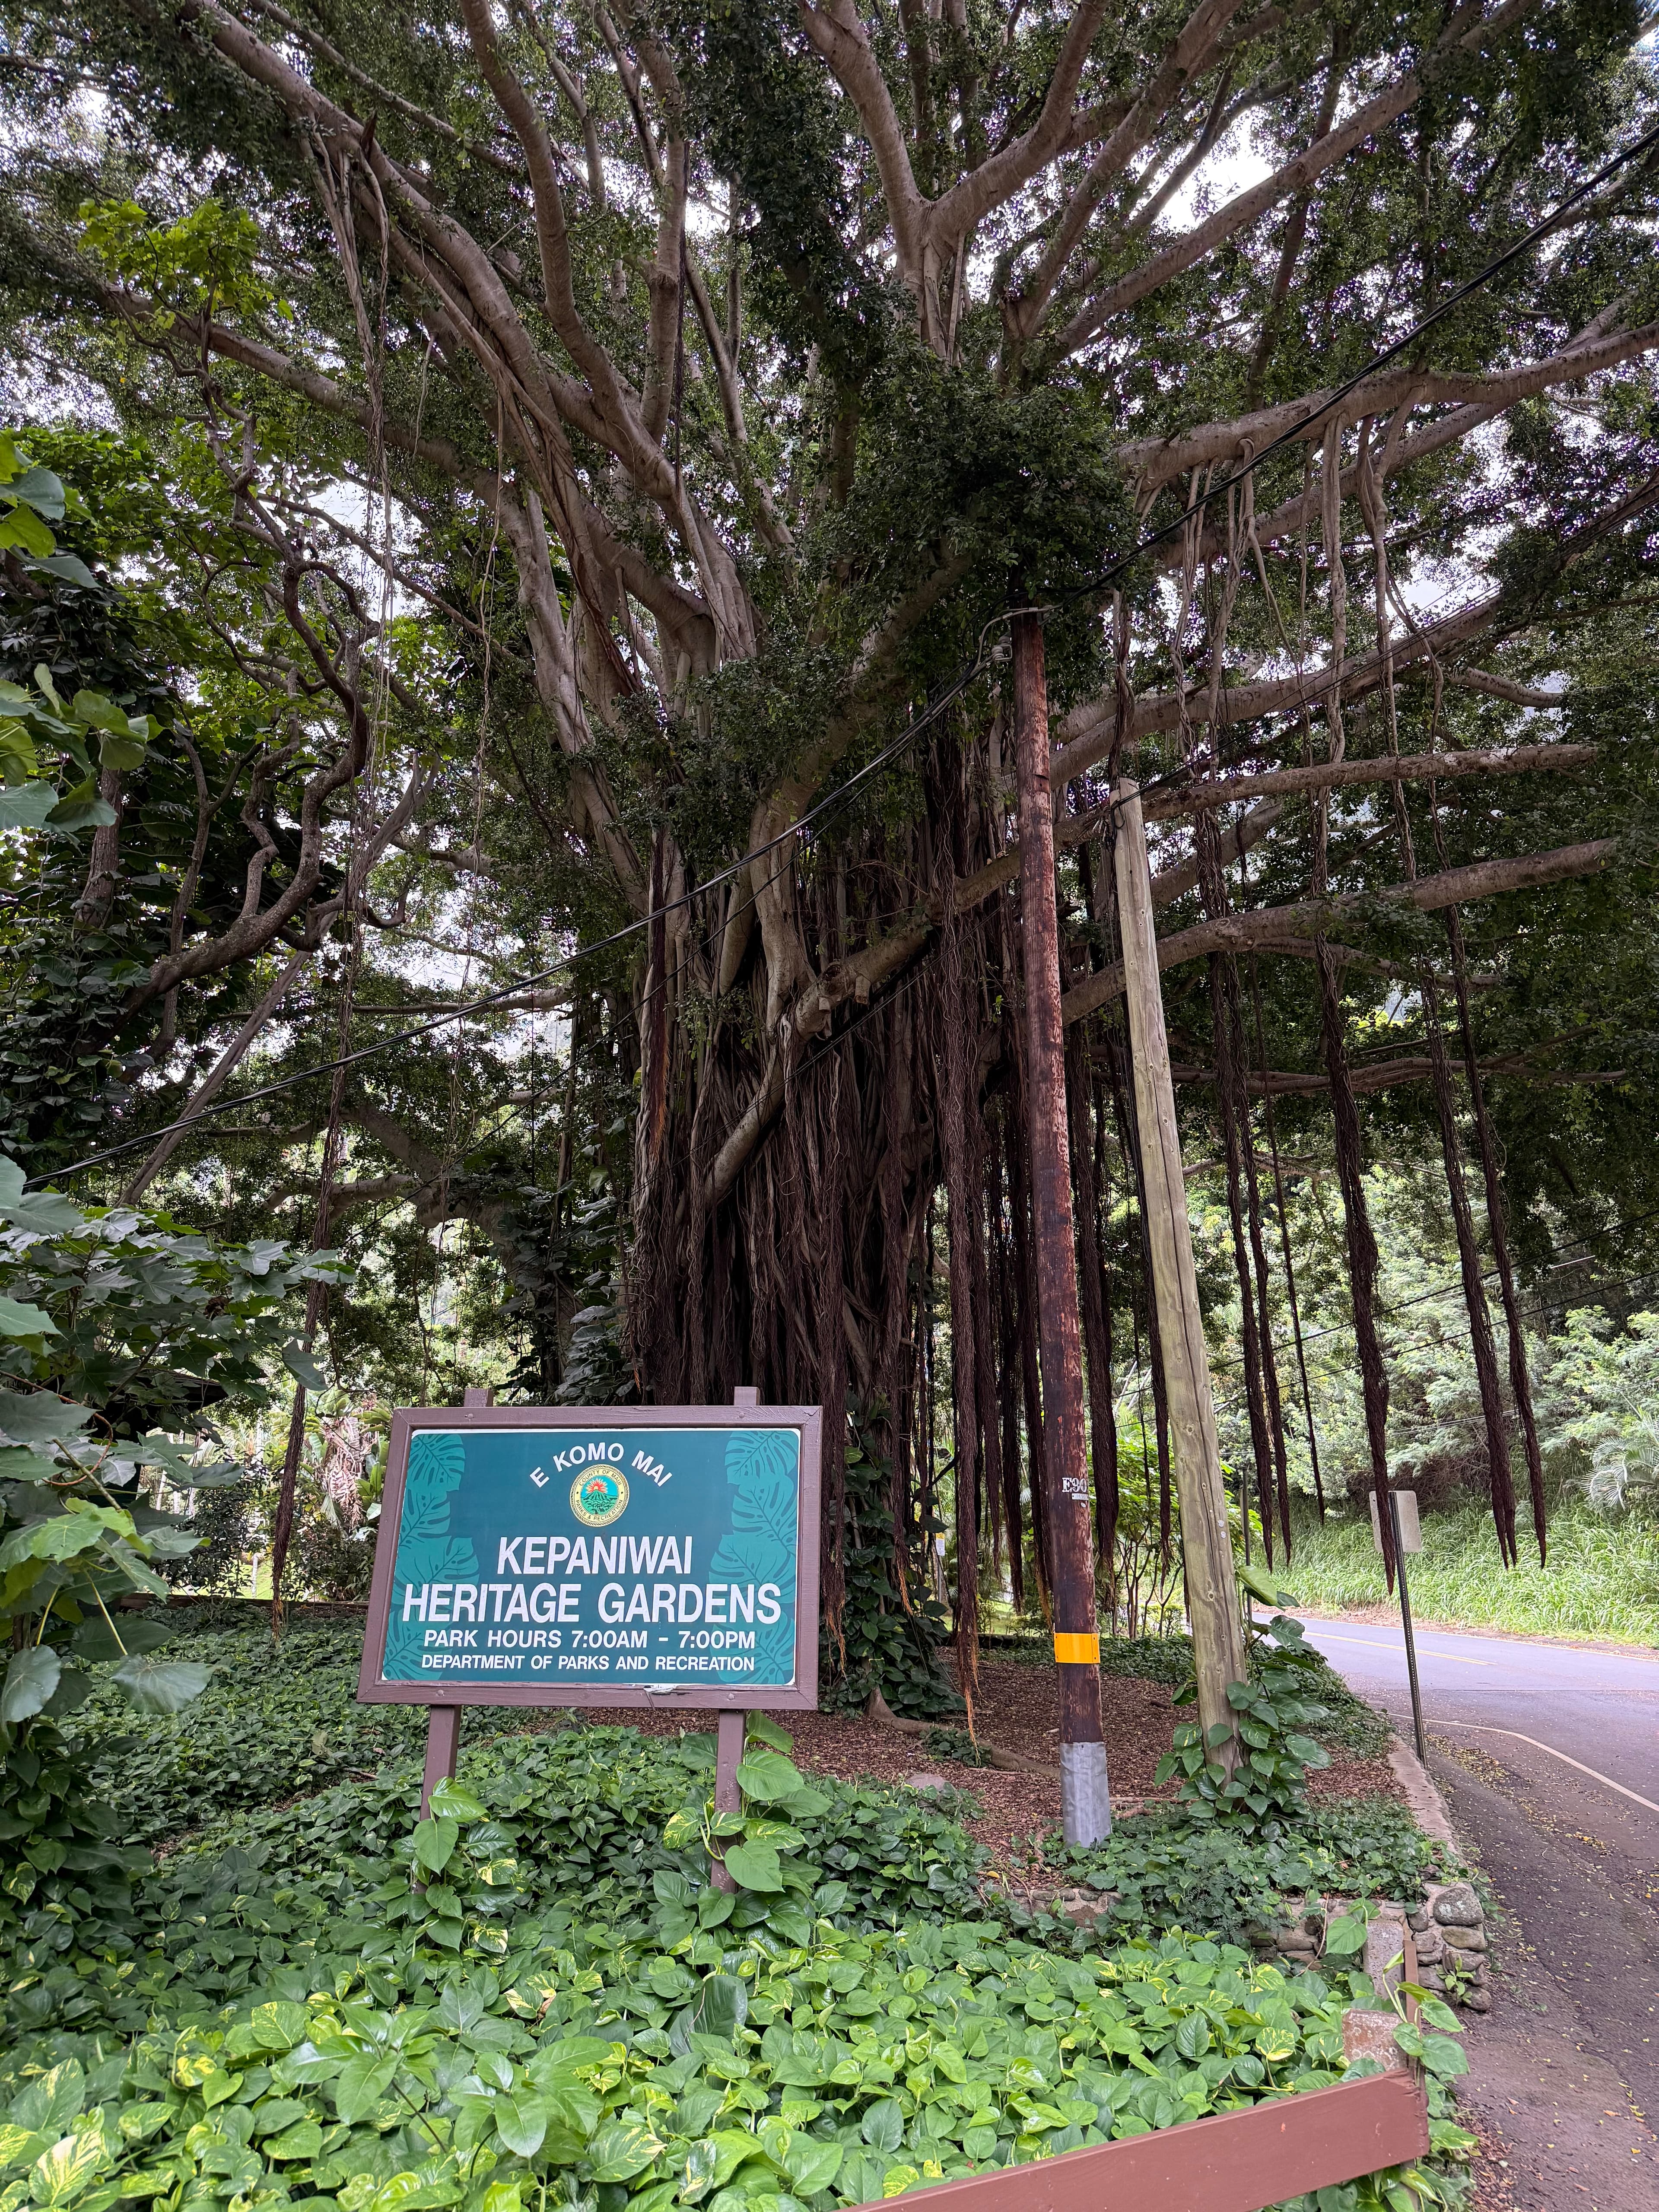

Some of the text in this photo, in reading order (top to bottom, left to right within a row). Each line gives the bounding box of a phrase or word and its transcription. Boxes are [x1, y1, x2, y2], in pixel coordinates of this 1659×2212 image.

[530, 1442, 673, 1488] E KOMO MAI
[579, 1470, 600, 1486] COUNTY
[611, 1473, 622, 1485] MAUI
[1062, 1477, 1087, 1493] E90
[575, 1500, 587, 1516] PARKS
[594, 1500, 623, 1521] RECREATION
[497, 1536, 693, 1574] KEPANIWAI
[402, 1583, 781, 1624] HERITAGE GARDENS
[424, 1630, 478, 1647] PARK
[487, 1630, 561, 1648] HOURS
[572, 1630, 648, 1648] 7:00AM
[678, 1630, 755, 1649] 7:00PM
[421, 1654, 754, 1671] DEPARTMENT OF PARKS AND RECREATION
